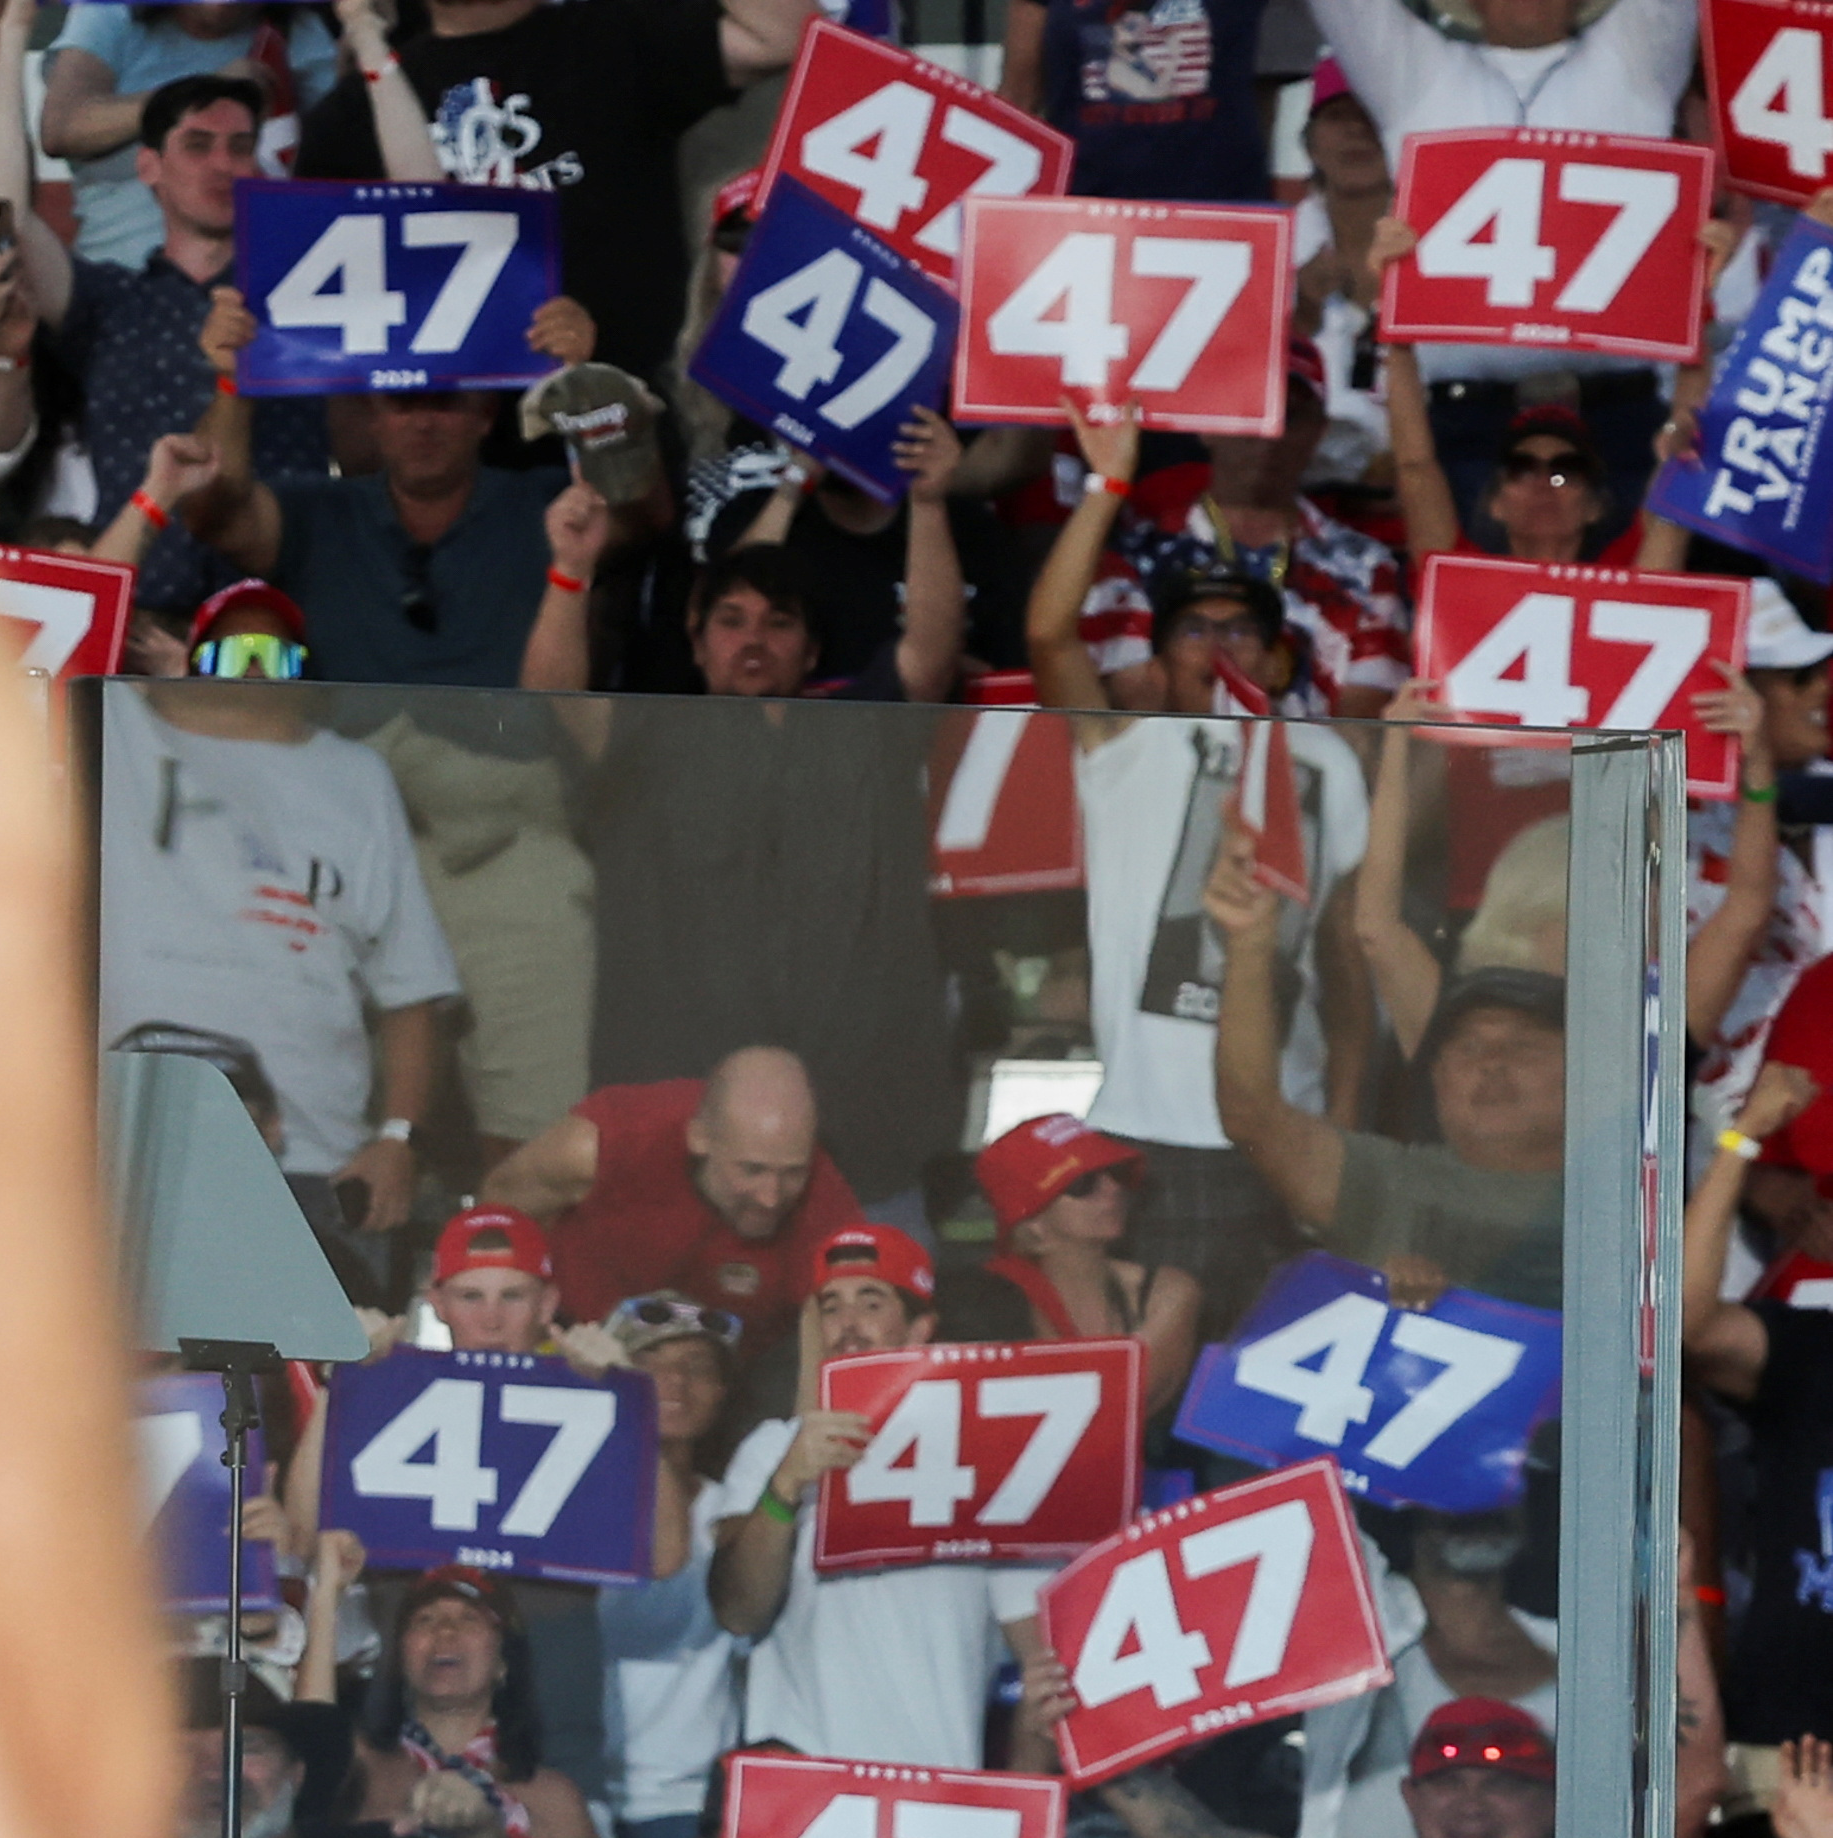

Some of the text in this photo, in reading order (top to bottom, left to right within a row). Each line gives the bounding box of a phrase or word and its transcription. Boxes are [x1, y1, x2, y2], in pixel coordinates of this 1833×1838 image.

[801, 82, 1043, 258] 47
[1417, 158, 1679, 314] 47
[268, 212, 520, 356] 47
[744, 248, 937, 430] 47
[988, 233, 1253, 392] 47
[371, 369, 427, 388] 2024
[1703, 246, 1833, 517] TRUMP
[1449, 594, 1711, 731] 47
[937, 711, 1032, 852] 7
[350, 1378, 618, 1538] 47
[847, 1371, 1101, 1528] 47
[1235, 1290, 1524, 1470] 47
[457, 1547, 514, 1570] 2024
[934, 1537, 993, 1559] 2024
[1335, 1466, 1369, 1495] 24
[1074, 1499, 1316, 1710] 47
[1190, 1703, 1254, 1733] 2024
